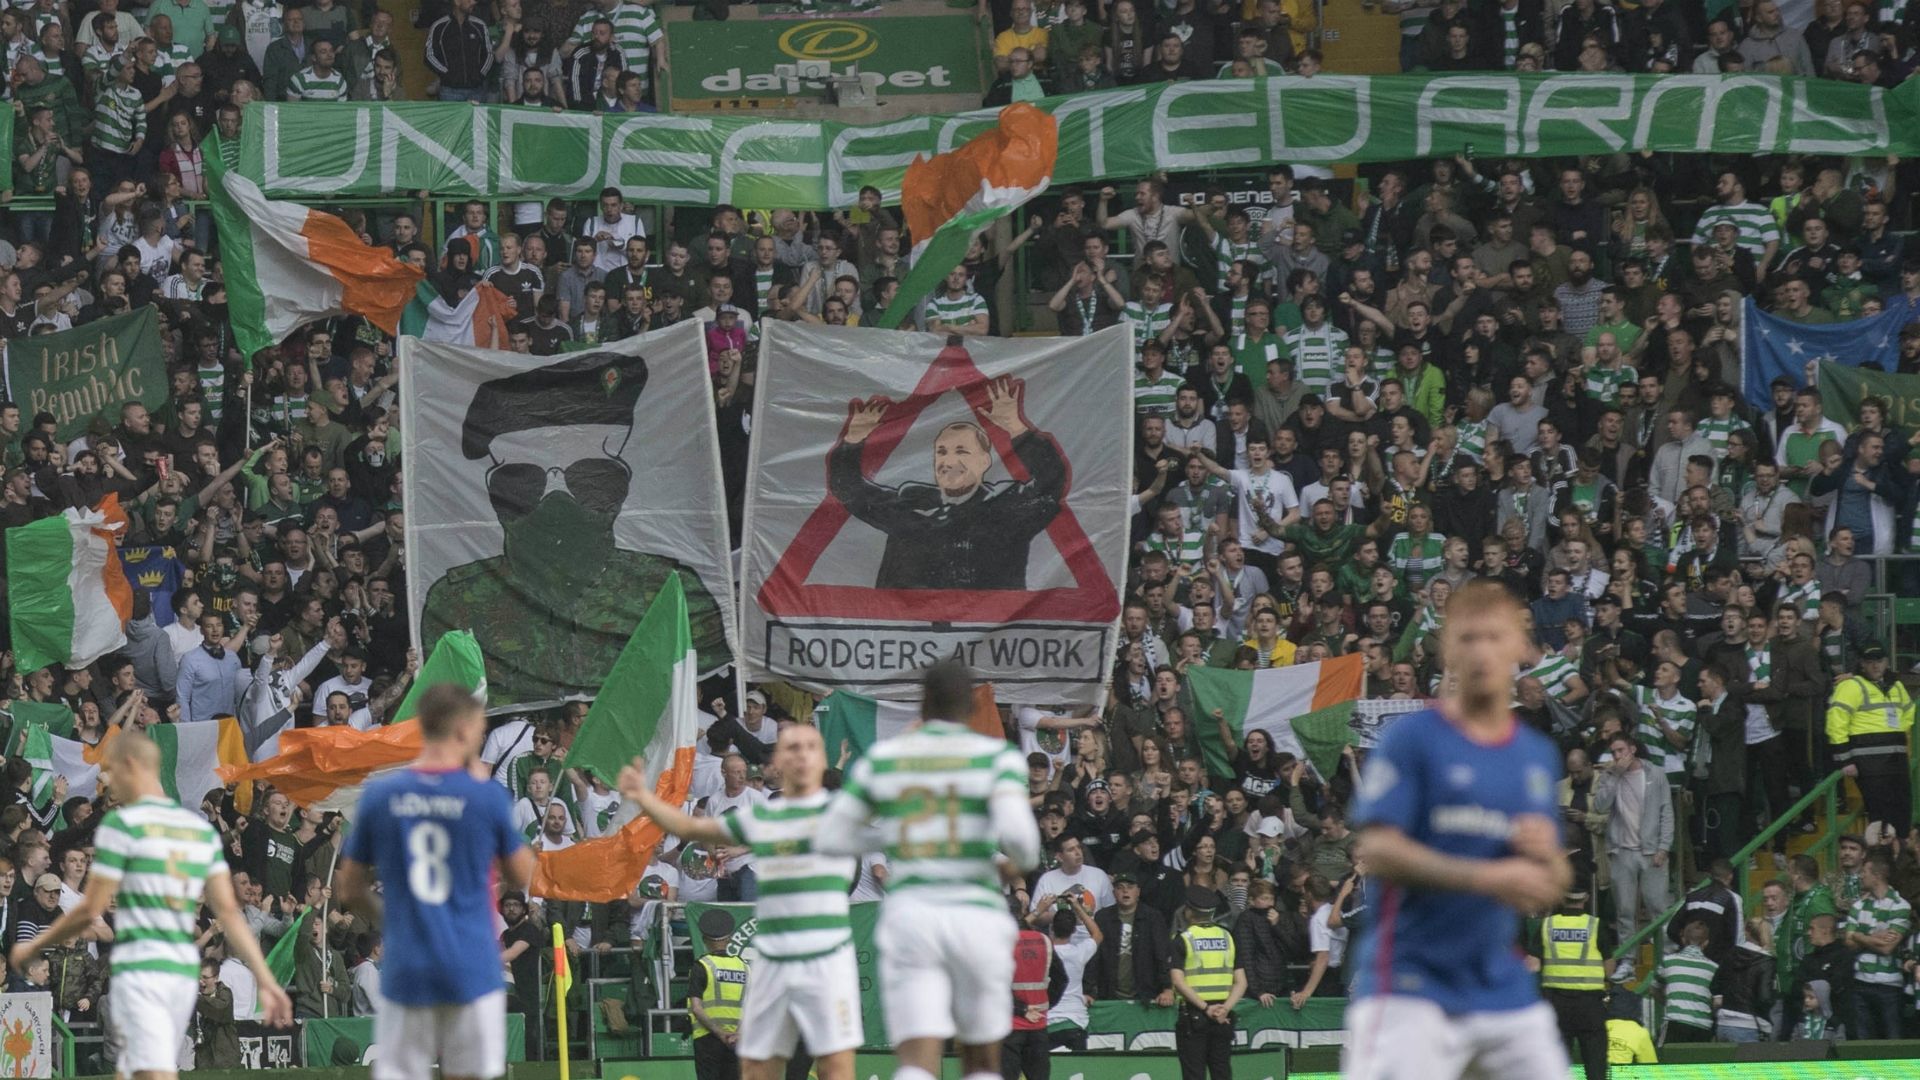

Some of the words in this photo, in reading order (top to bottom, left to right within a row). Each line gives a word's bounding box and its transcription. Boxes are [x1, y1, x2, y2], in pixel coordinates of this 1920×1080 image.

[264, 76, 1371, 207] UNDEFETED
[1417, 74, 1889, 155] ARMY
[789, 639, 937, 671] RODGERS
[951, 640, 978, 669] AT
[990, 636, 1085, 668] WORK
[897, 782, 962, 861] 21
[408, 820, 453, 906] 8
[1195, 938, 1227, 951] POLICE
[1553, 929, 1588, 941] POLICE
[717, 970, 746, 984] POLICE
